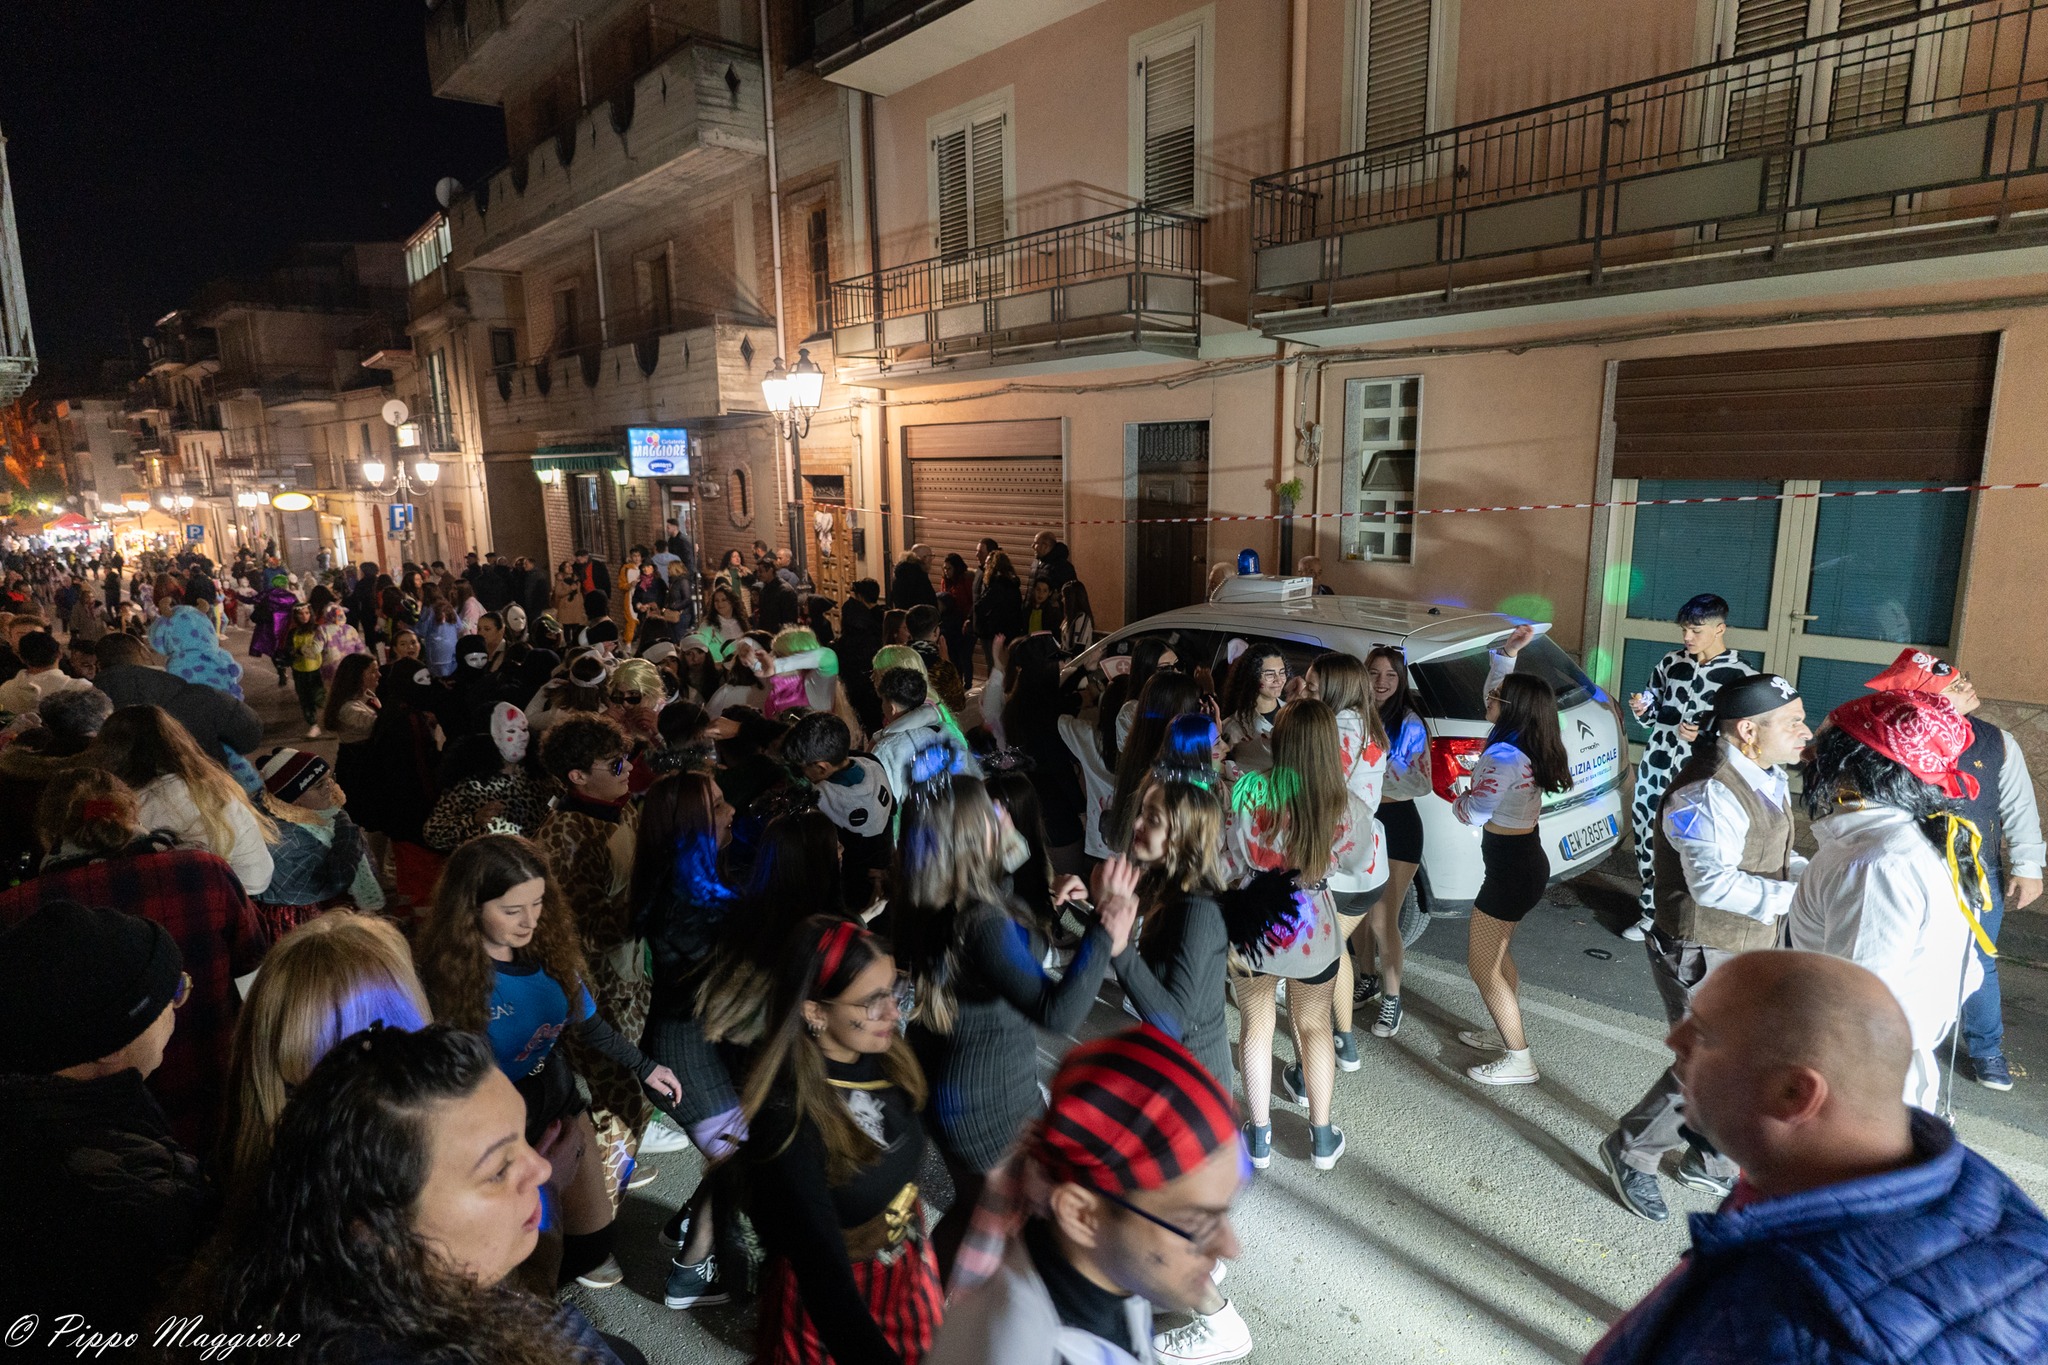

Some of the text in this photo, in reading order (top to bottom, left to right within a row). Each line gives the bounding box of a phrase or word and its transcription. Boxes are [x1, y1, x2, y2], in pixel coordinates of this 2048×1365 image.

[633, 445, 686, 457] MAGGIORE
[190, 526, 200, 537] P
[1570, 748, 1617, 777] LIZIA LOCALE
